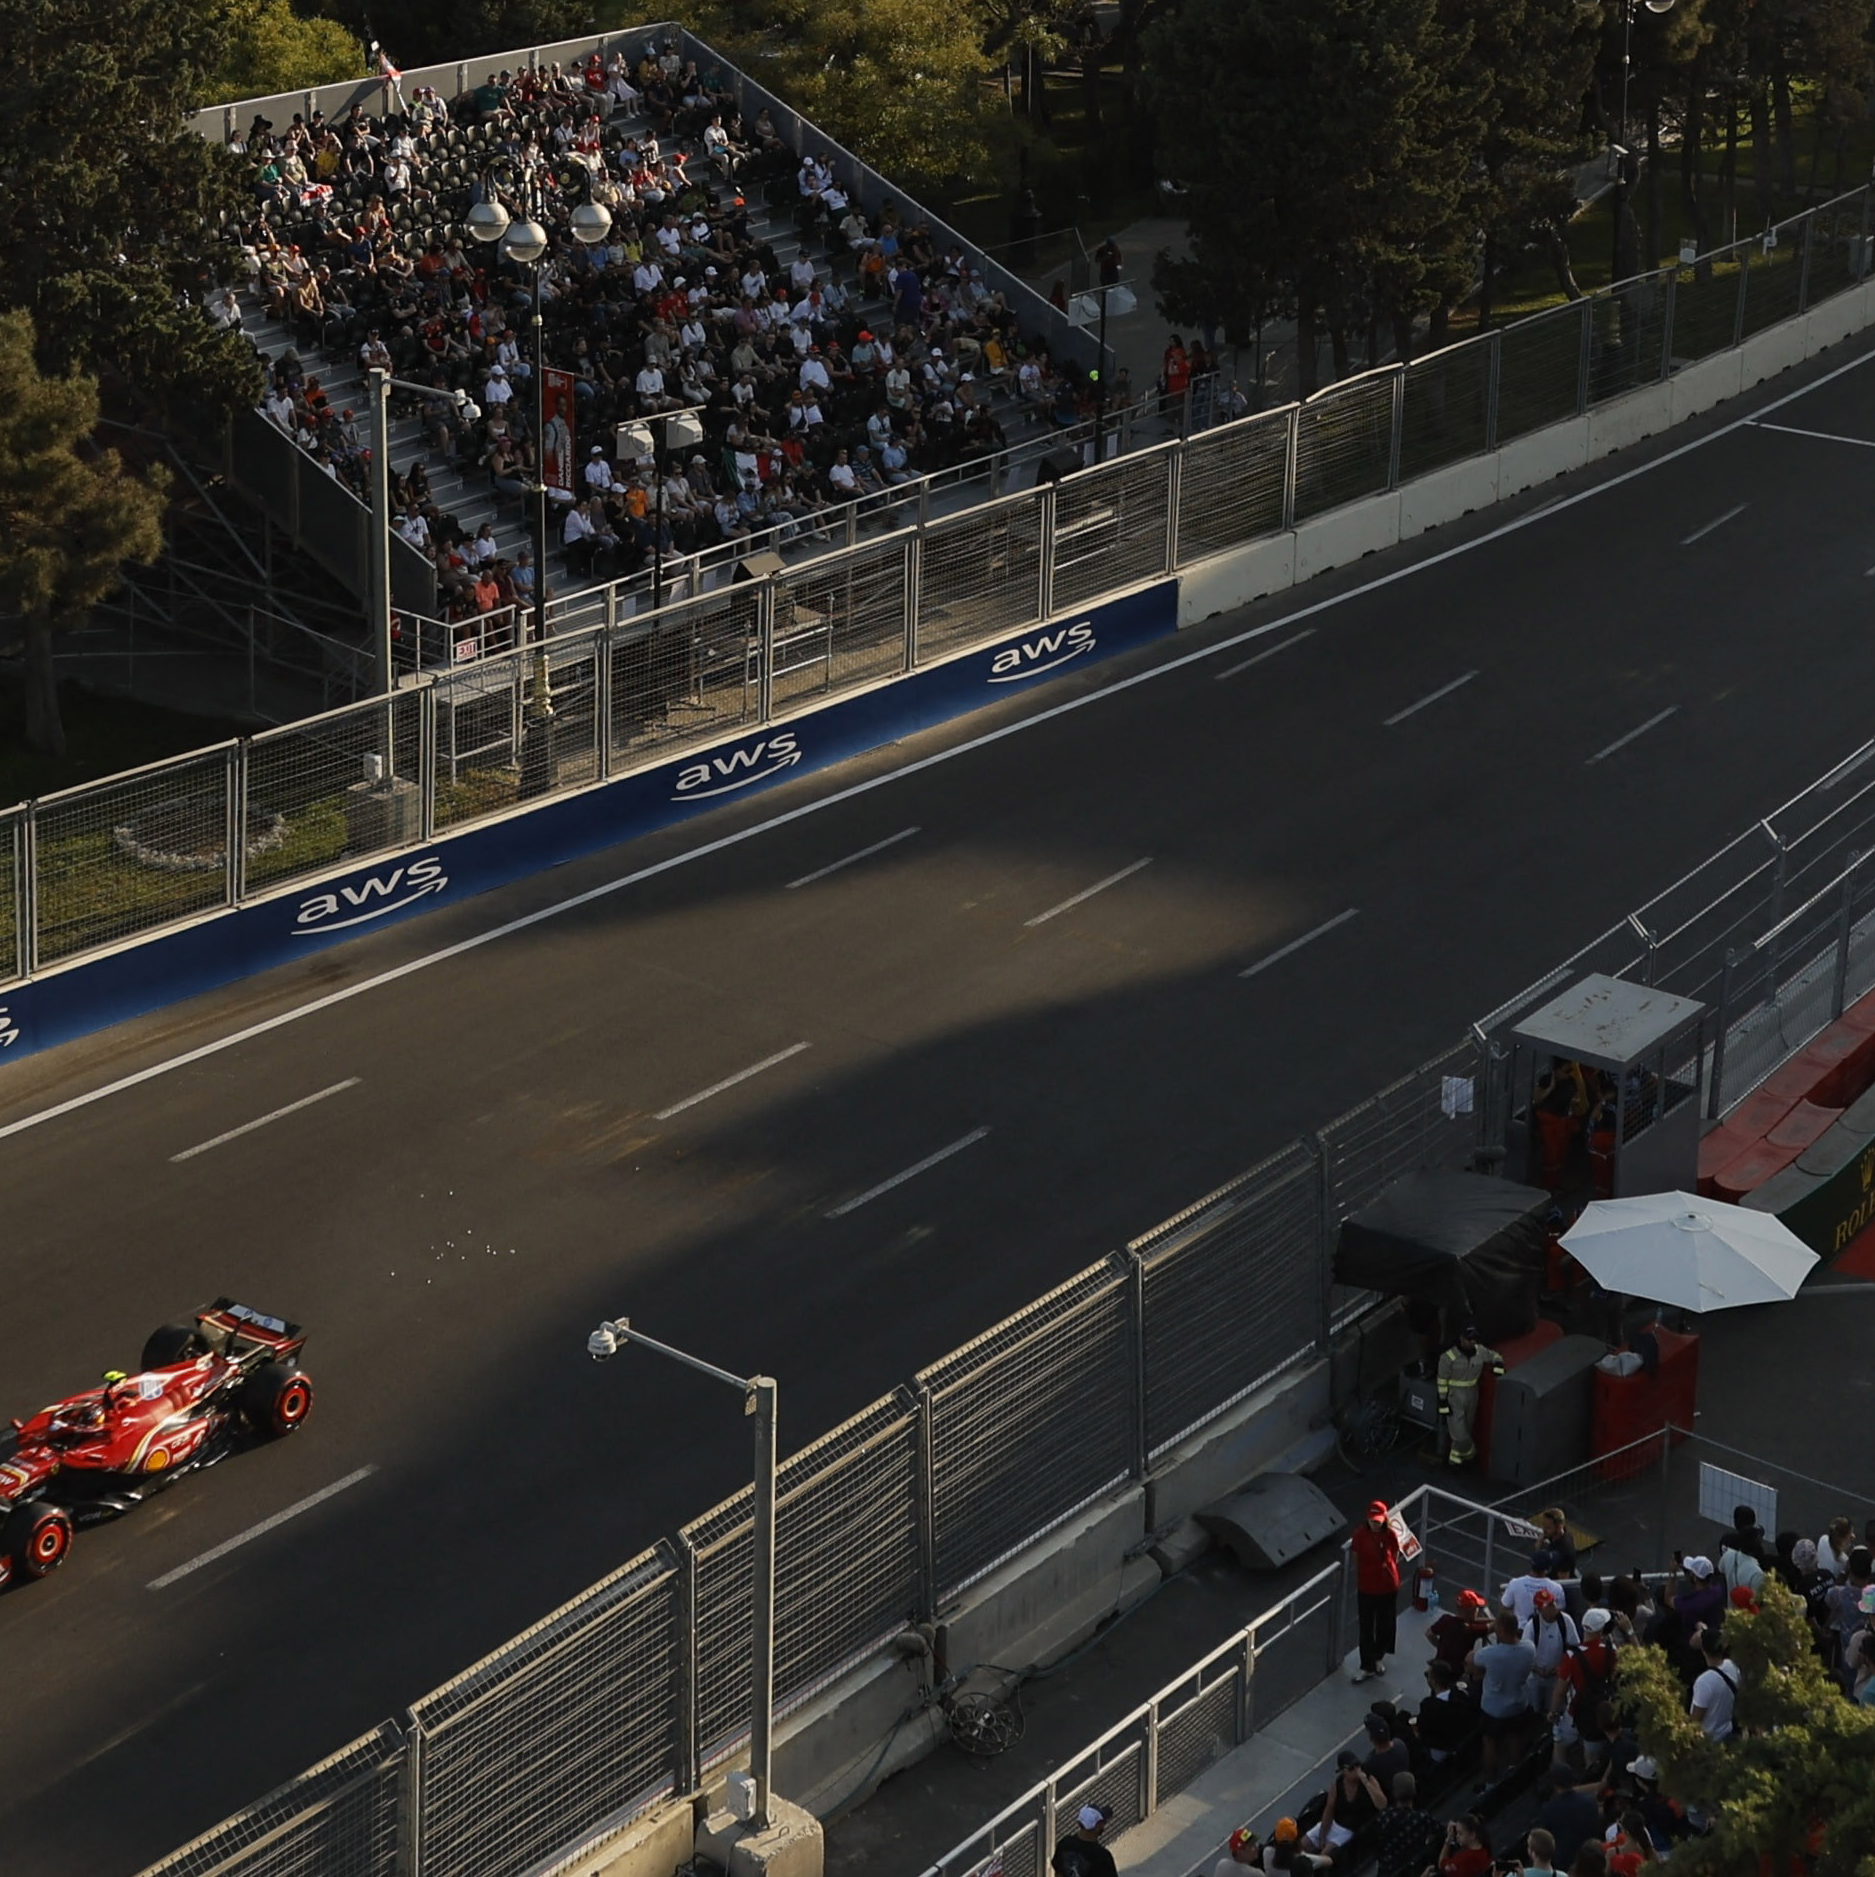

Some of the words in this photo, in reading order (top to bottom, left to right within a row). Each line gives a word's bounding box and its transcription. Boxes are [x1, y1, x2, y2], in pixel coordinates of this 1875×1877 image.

[991, 621, 1092, 673] aws
[676, 732, 797, 790] aws
[297, 856, 442, 924] aws
